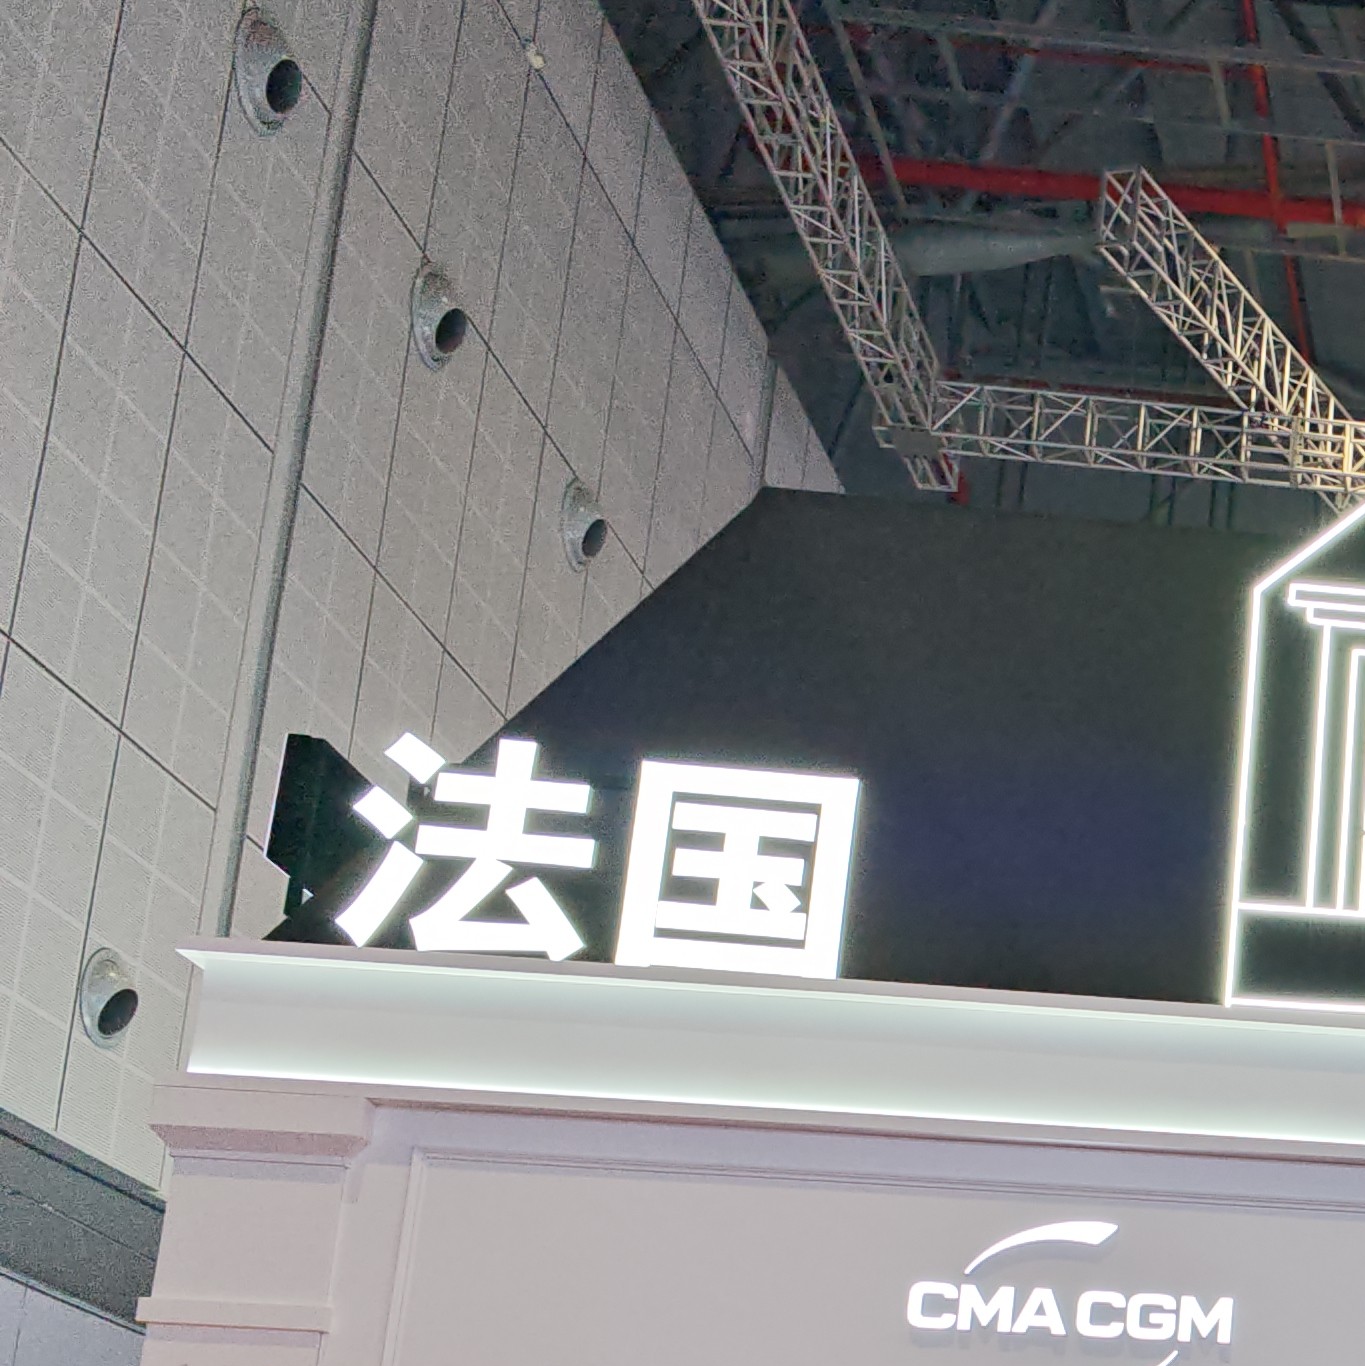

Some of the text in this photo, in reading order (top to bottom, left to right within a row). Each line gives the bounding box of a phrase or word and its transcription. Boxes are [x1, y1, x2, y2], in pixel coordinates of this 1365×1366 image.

[334, 731, 861, 980] 法国
[906, 1280, 1234, 1344] CMA CGM
